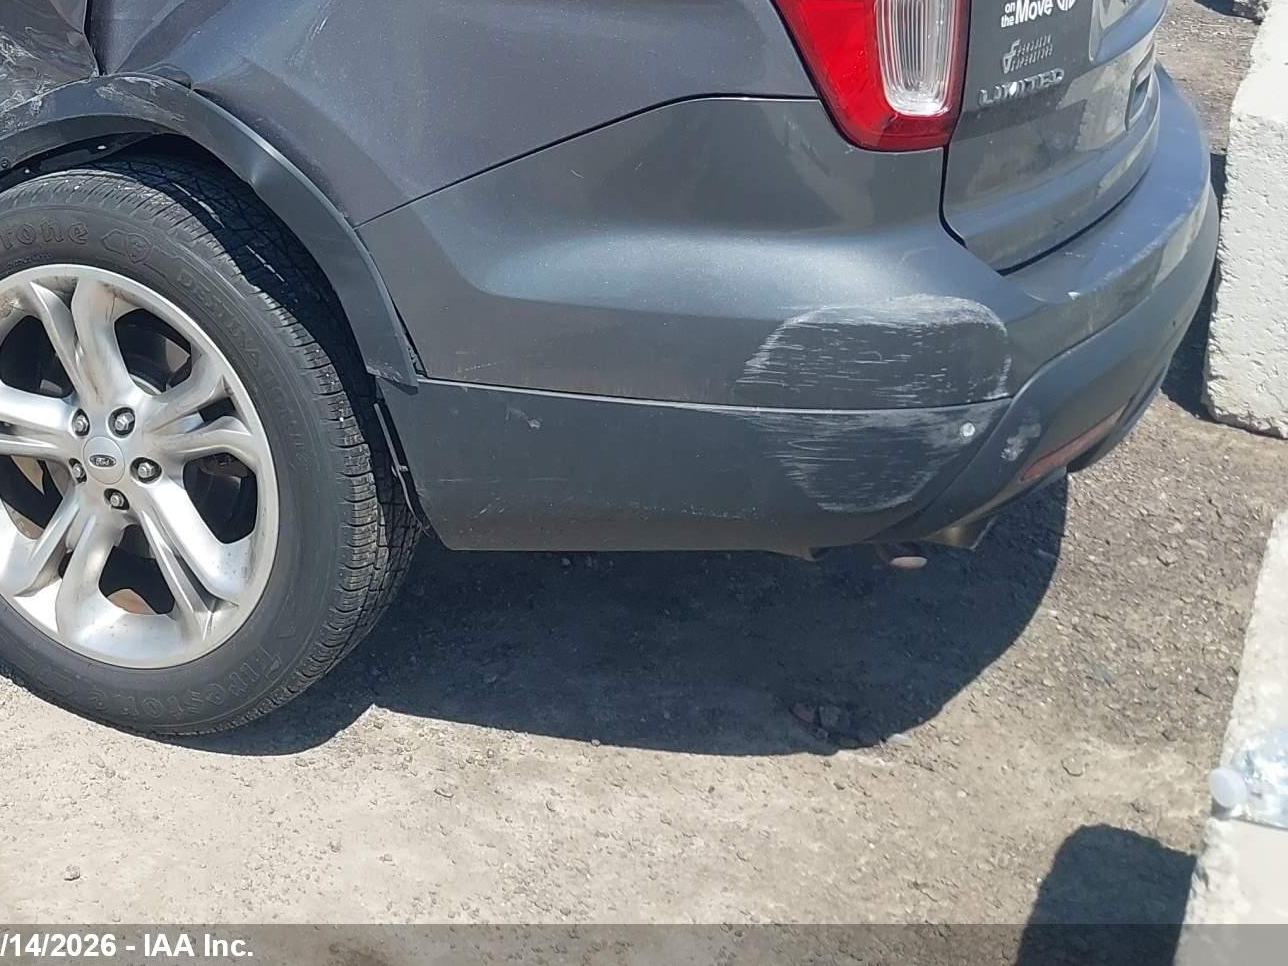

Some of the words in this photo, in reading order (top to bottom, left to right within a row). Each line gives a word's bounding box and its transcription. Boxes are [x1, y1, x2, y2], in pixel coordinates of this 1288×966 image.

[1004, 1, 1016, 15] on
[1001, 13, 1015, 28] the
[979, 67, 1065, 106] LIMITED
